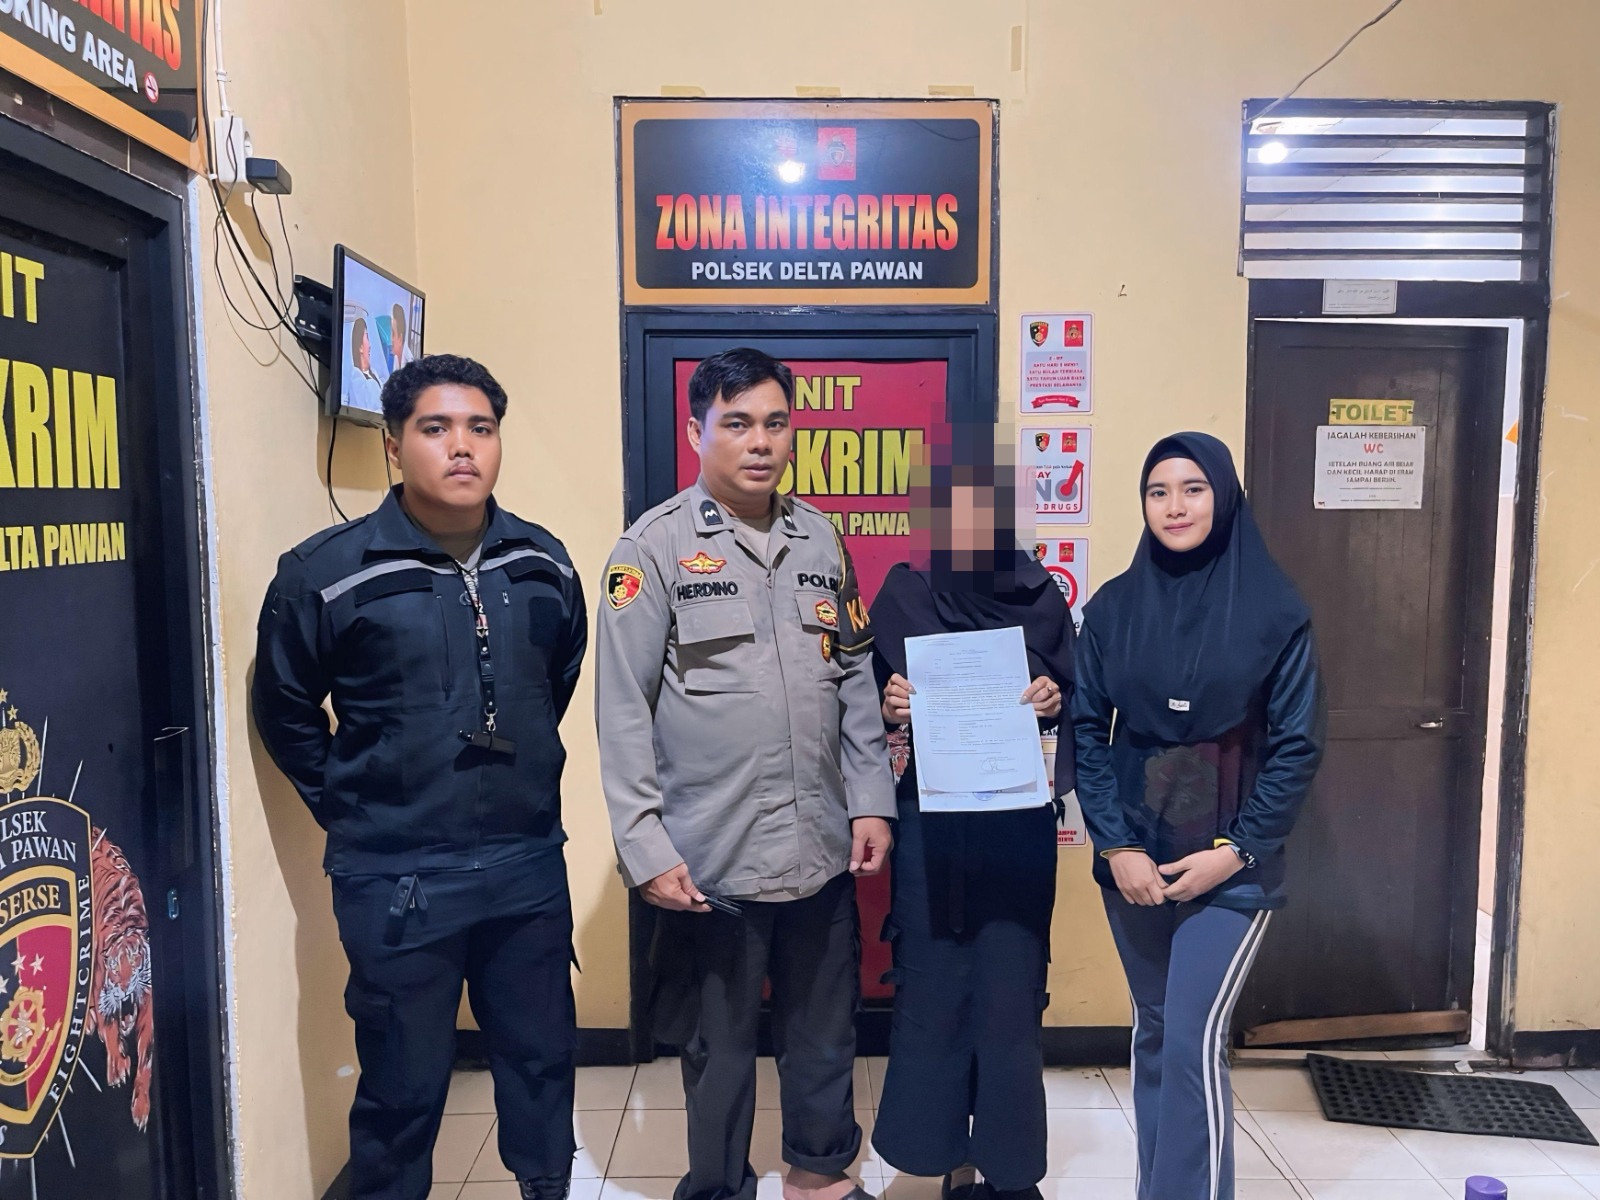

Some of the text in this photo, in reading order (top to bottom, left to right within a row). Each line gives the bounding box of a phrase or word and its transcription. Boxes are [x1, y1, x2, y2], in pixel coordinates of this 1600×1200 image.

[82, 31, 138, 93] AREA
[656, 193, 959, 251] ZONA INTEGRITAS
[691, 261, 923, 280] POLSEK DELTA PAWAN
[795, 376, 861, 410] NIT
[1332, 404, 1412, 421] TOILET
[1327, 432, 1367, 440] JAGALAH
[1363, 443, 1384, 453] WC
[778, 428, 924, 496] KRIM
[848, 512, 911, 536] PAWA
[43, 522, 126, 567] PAWAN
[677, 580, 739, 602] HERDINO
[1, 811, 47, 842] LSEK
[11, 836, 76, 863] PAWAN
[0, 884, 61, 928] SERSE
